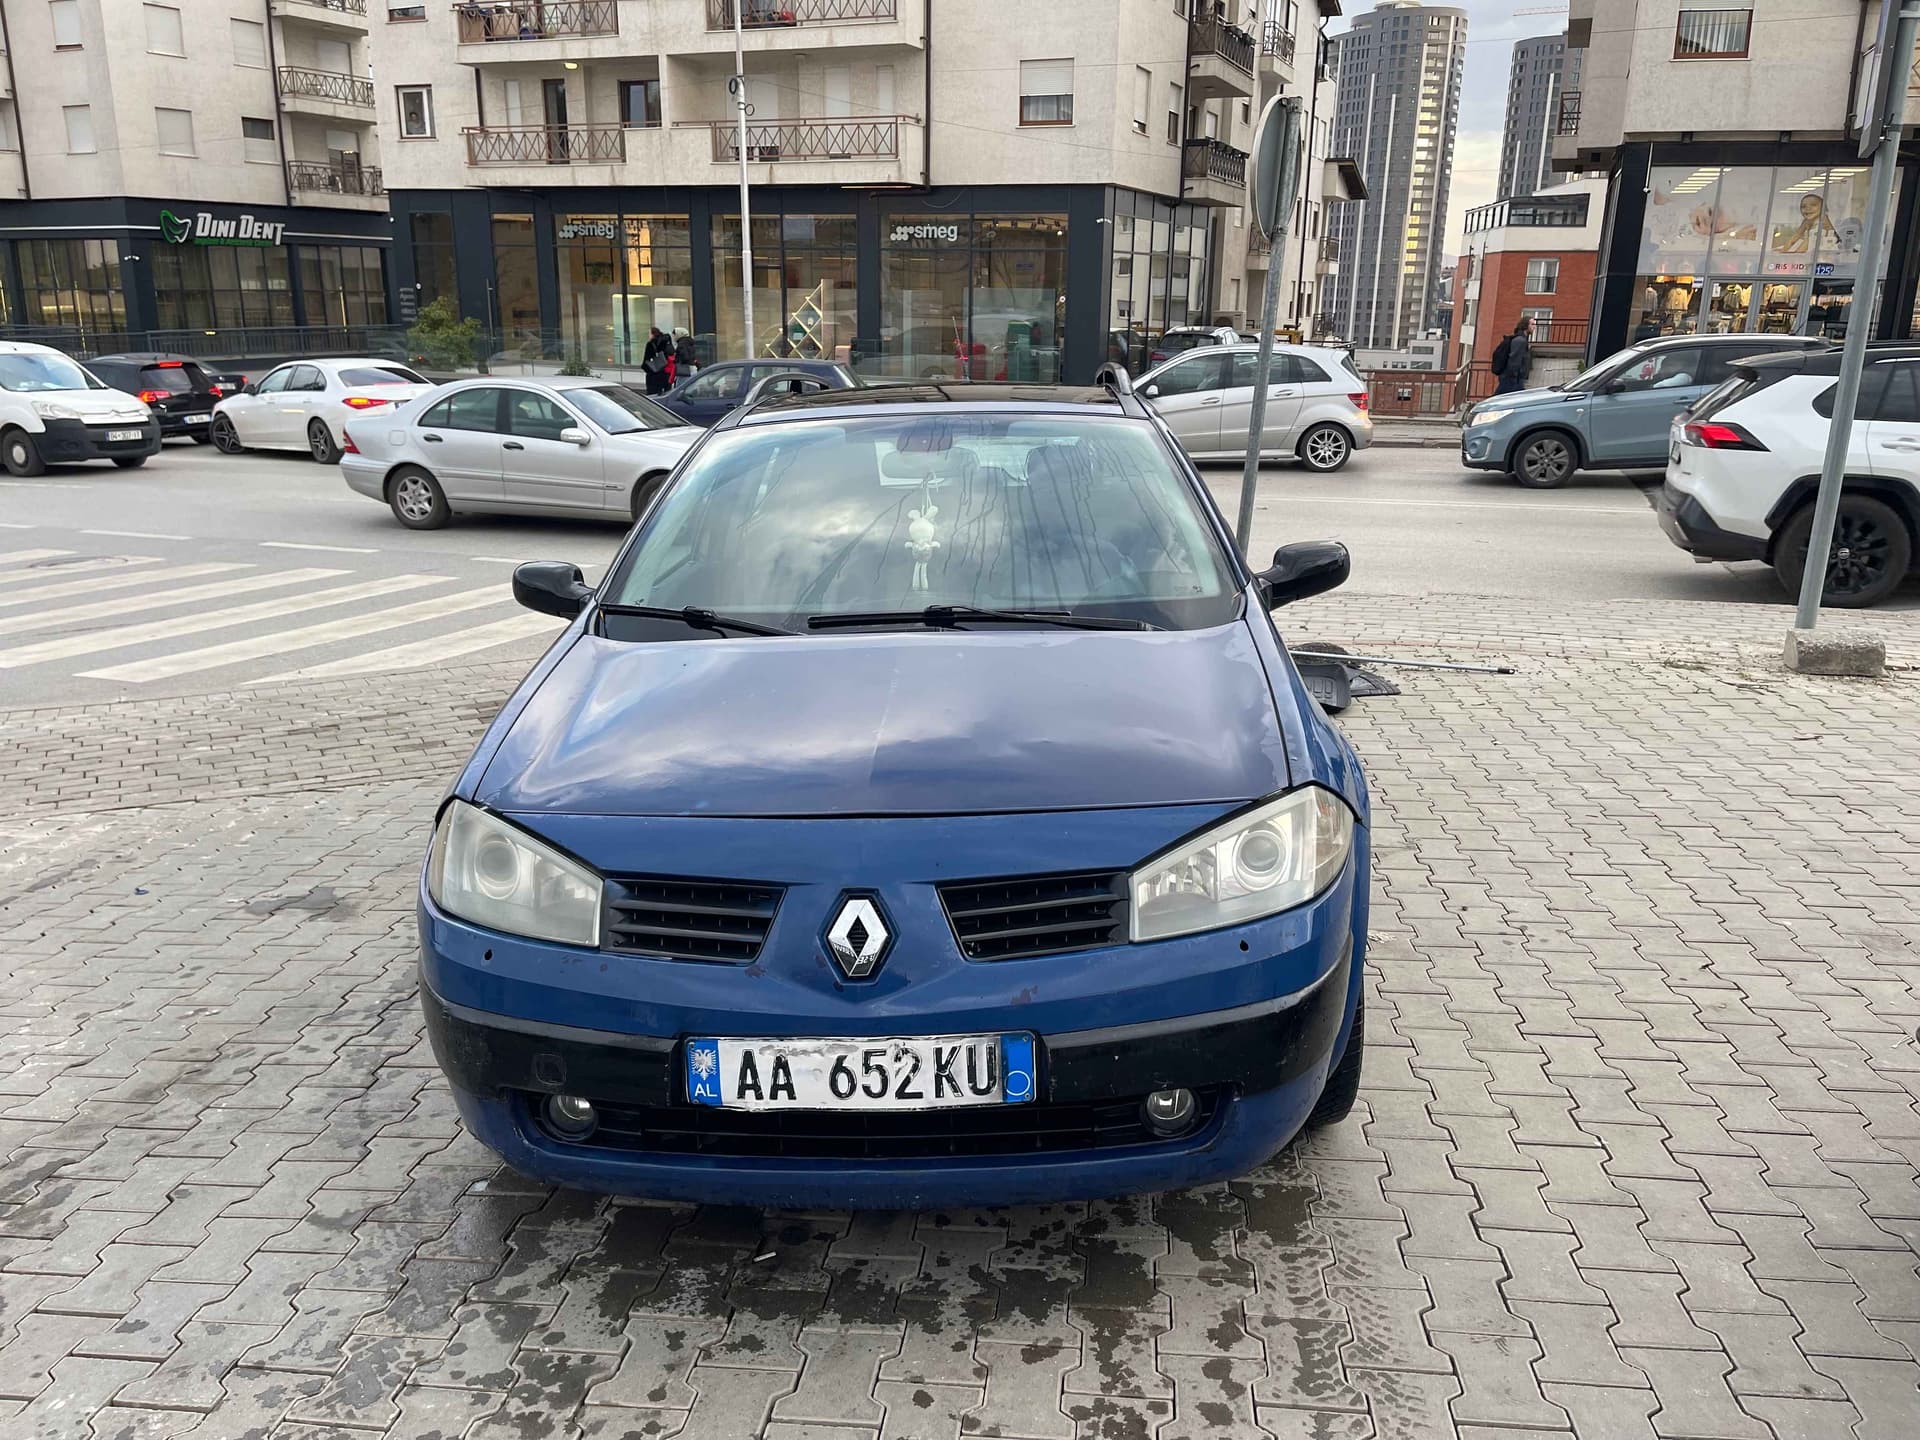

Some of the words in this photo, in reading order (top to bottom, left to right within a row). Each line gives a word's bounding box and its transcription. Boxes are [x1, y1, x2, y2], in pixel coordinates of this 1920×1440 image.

[195, 213, 237, 238] DINI
[238, 214, 286, 246] DENT
[578, 223, 615, 239] smeg
[913, 225, 958, 242] smeg
[736, 1049, 797, 1100] AA
[694, 1083, 718, 1097] AL
